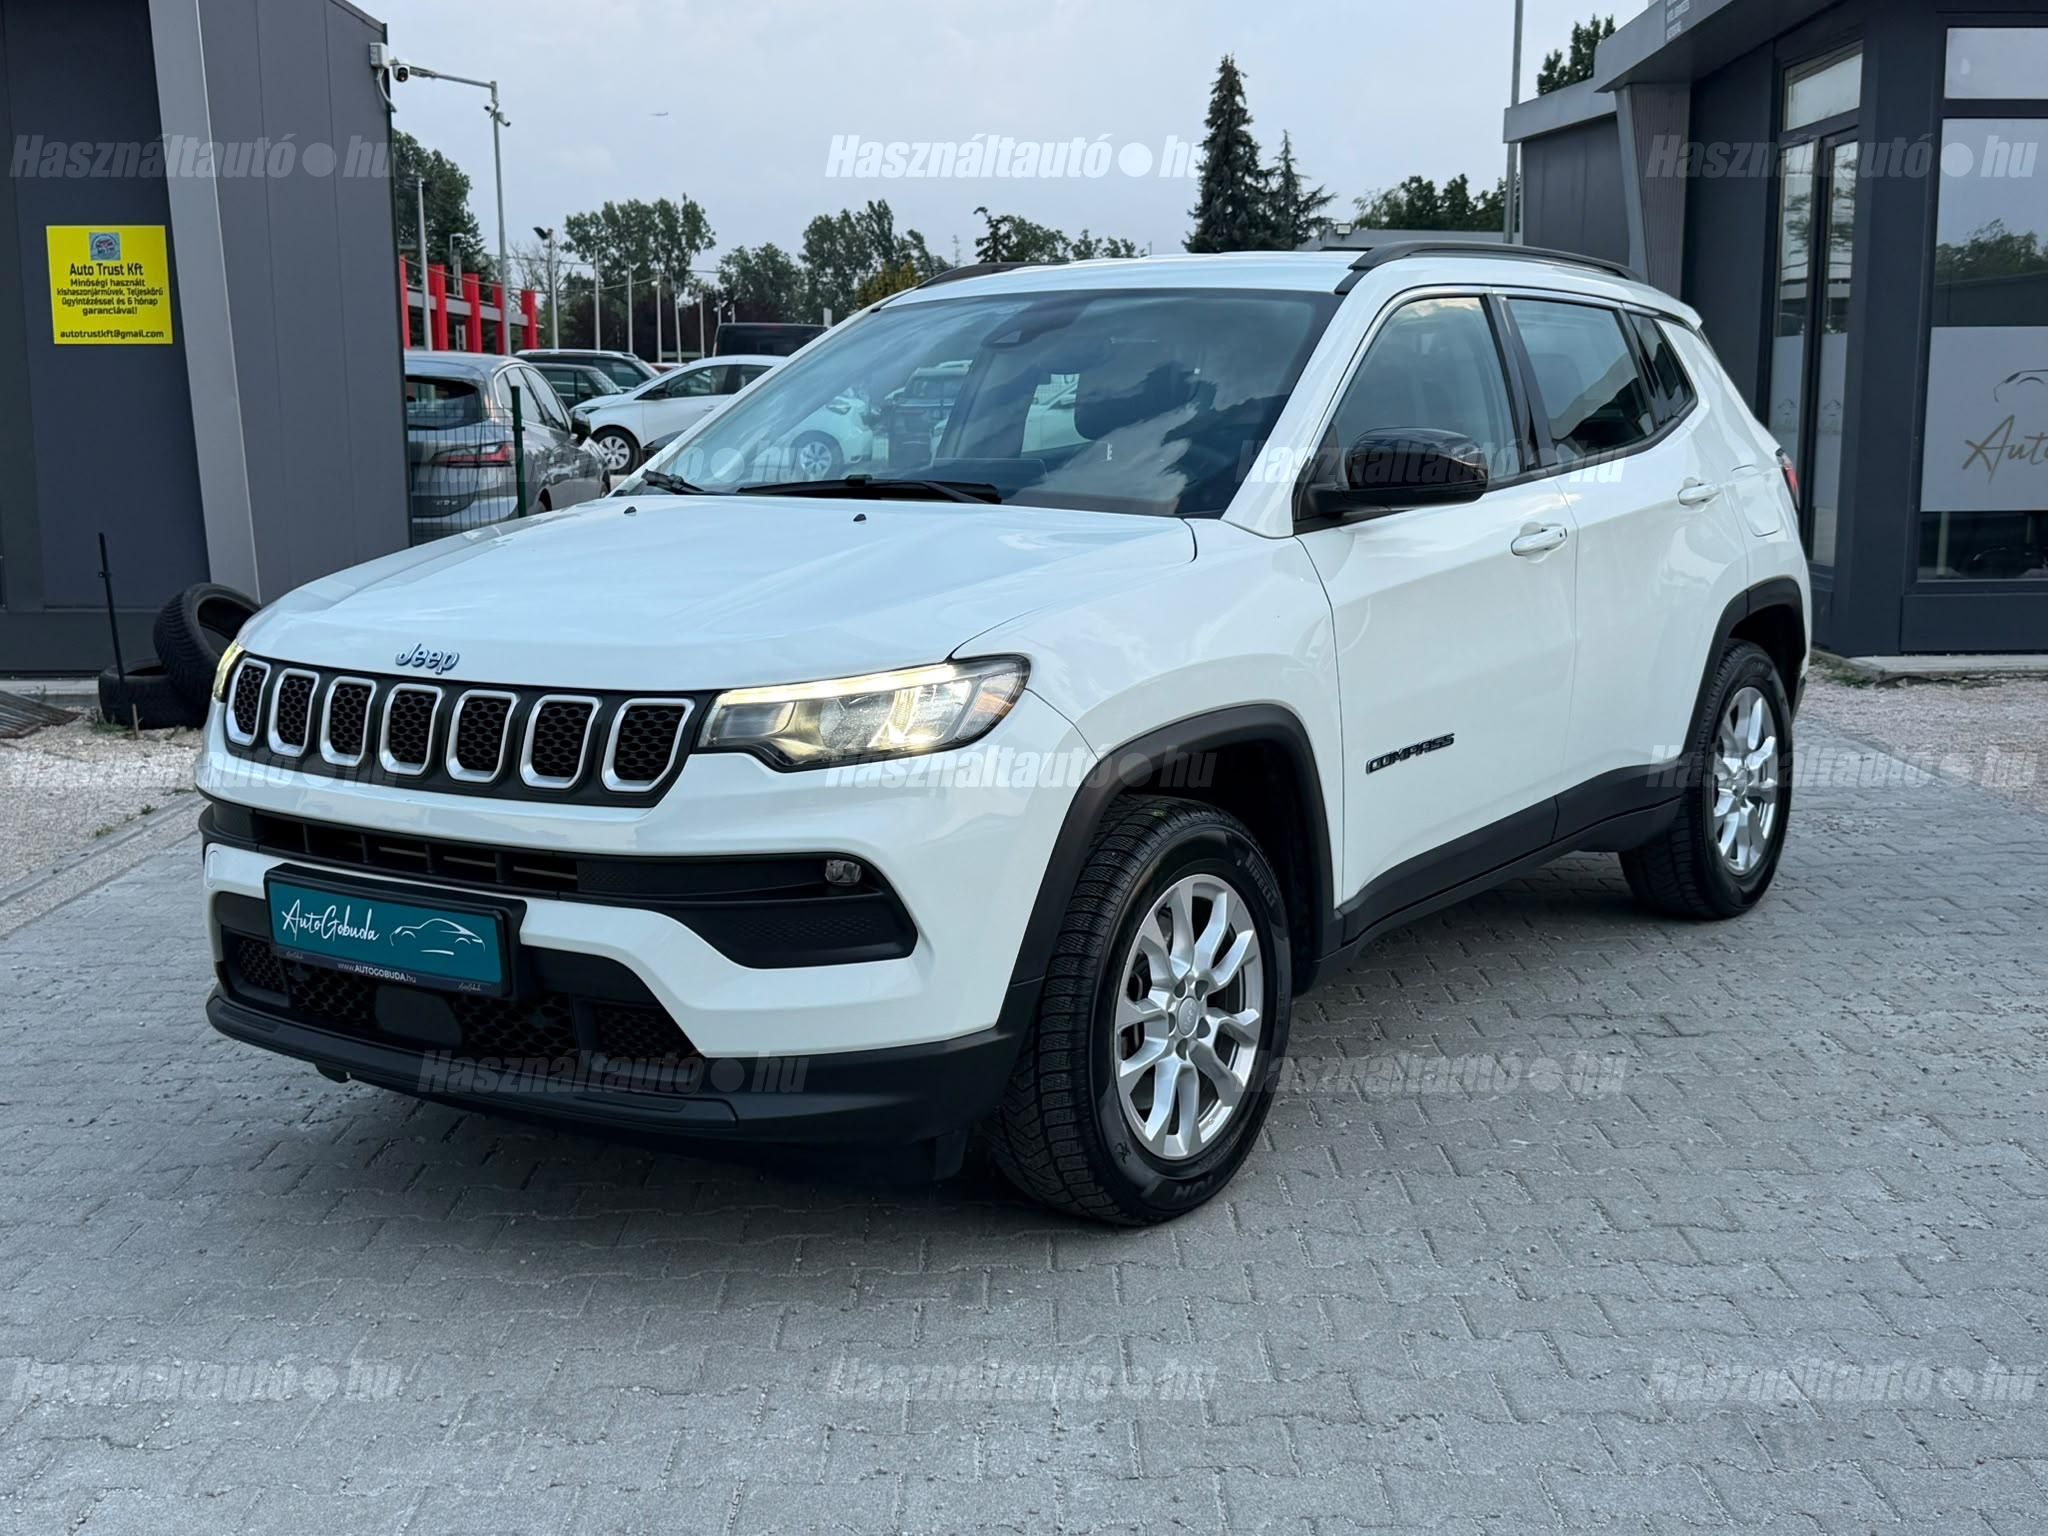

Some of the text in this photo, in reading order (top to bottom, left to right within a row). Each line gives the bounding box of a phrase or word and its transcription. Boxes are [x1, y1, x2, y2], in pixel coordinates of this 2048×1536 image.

[69, 263, 144, 276] Auto Trust Kft
[60, 329, 165, 339] autotrustkft@gmail.com
[395, 642, 460, 675] Jeep
[1365, 732, 1456, 775] COMPASS
[281, 898, 380, 942] AutoGobuda
